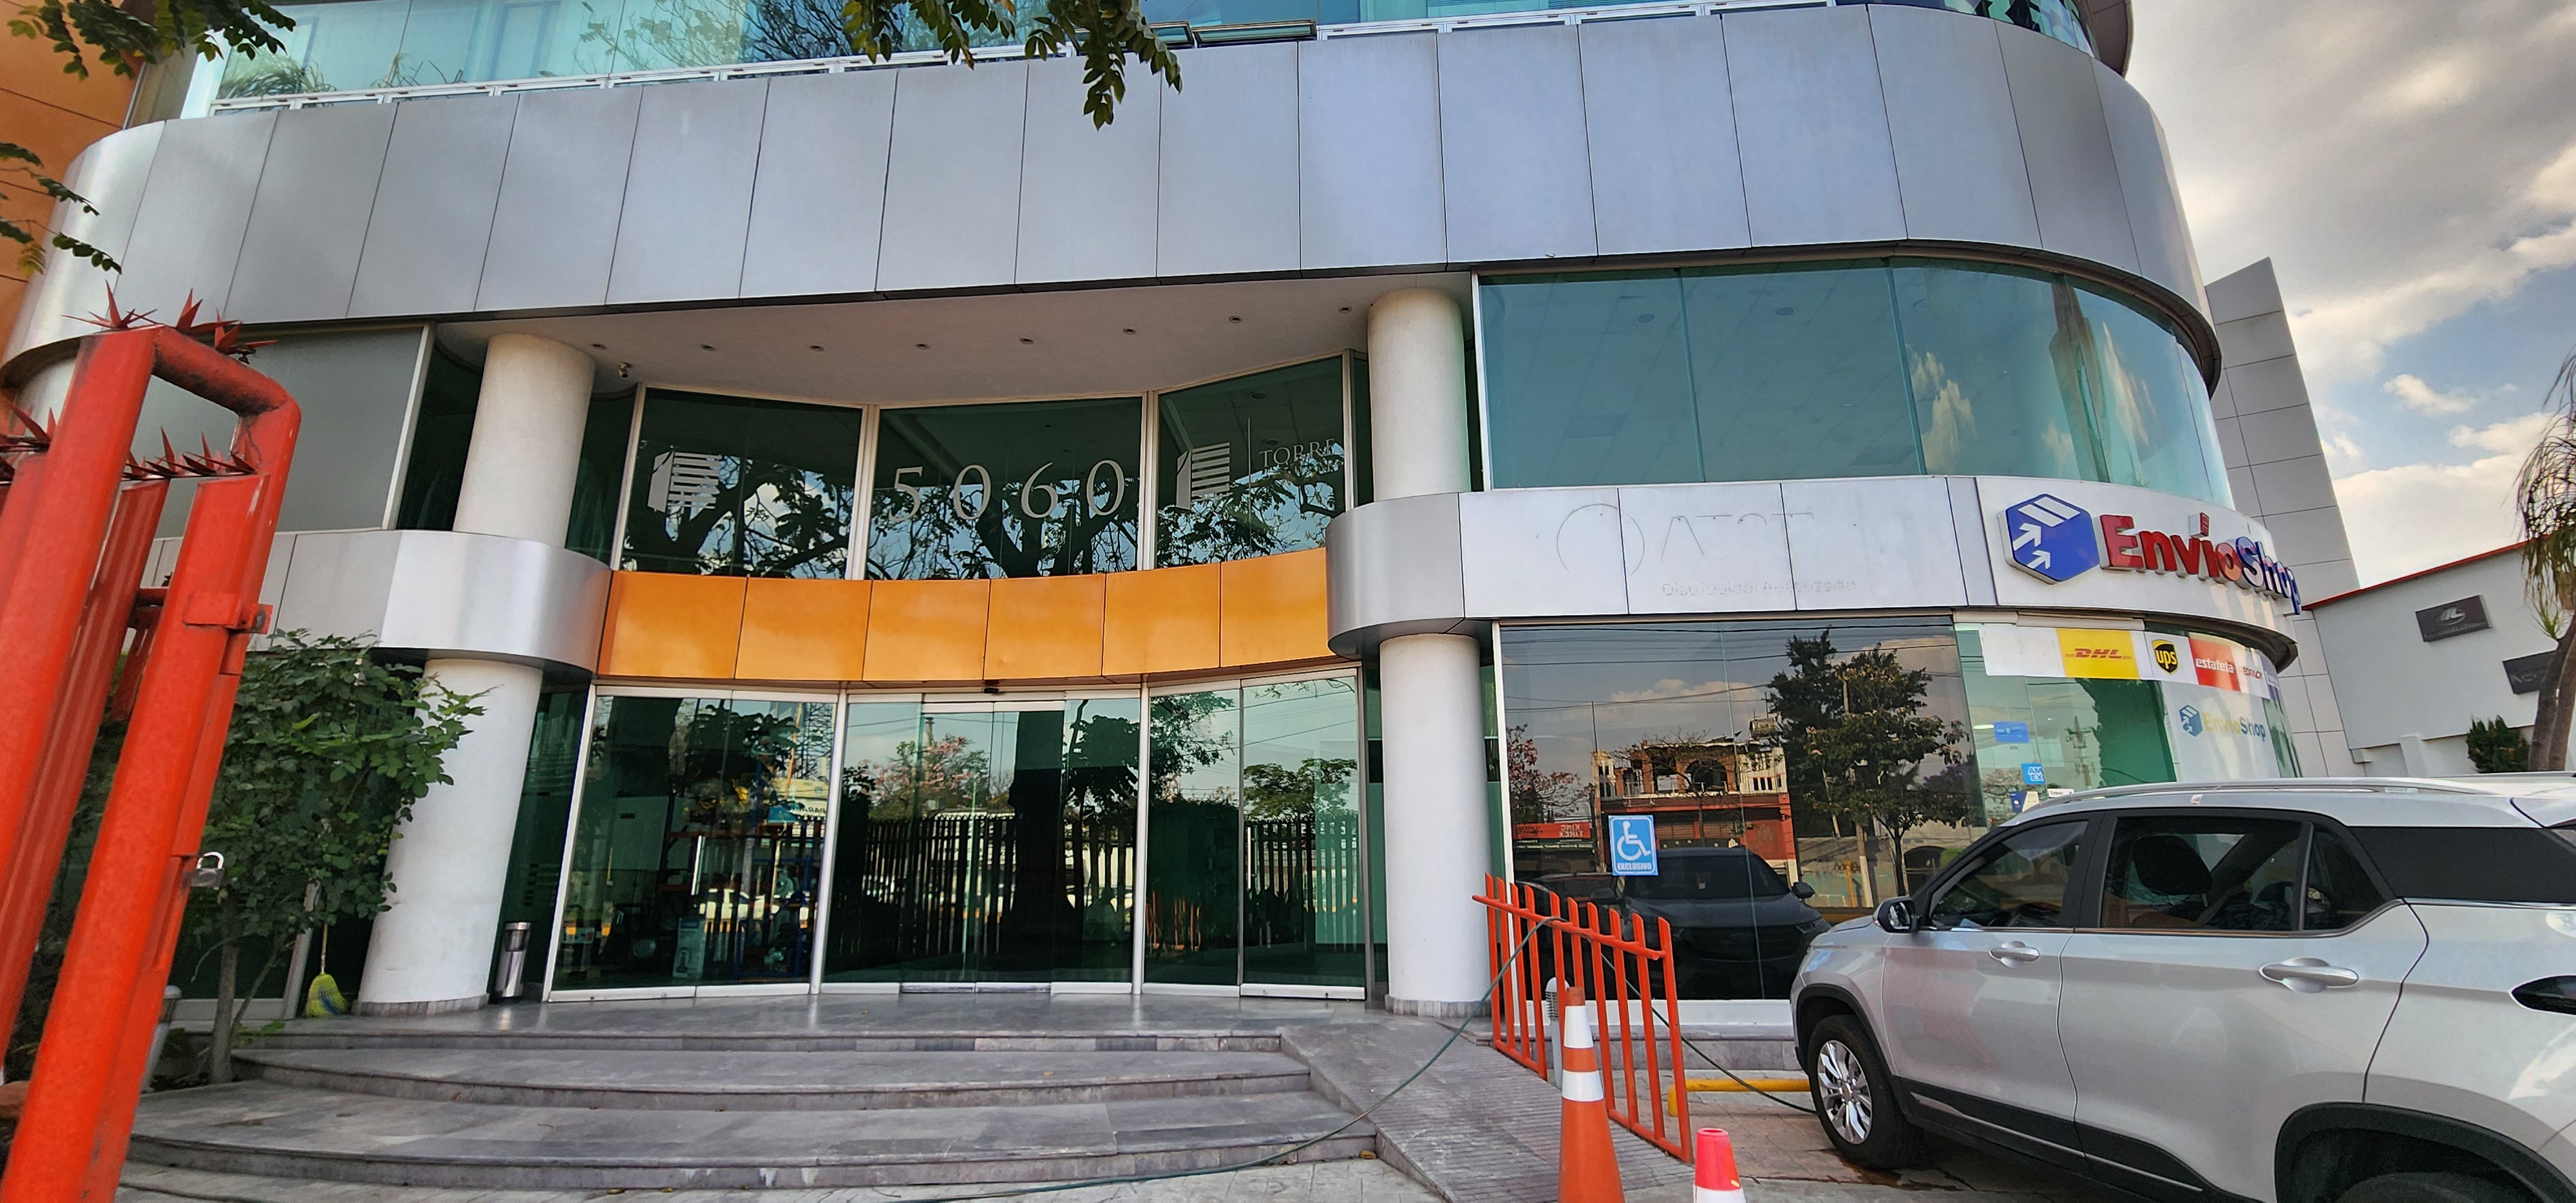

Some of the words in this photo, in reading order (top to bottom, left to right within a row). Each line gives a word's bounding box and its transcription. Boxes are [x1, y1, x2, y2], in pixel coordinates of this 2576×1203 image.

[1259, 439, 1335, 468] TORRE
[2074, 647, 2123, 659] DHL
[2155, 649, 2177, 670] ups
[2195, 658, 2235, 674] estafeta
[1617, 862, 1652, 871] EXCLUSIVO
